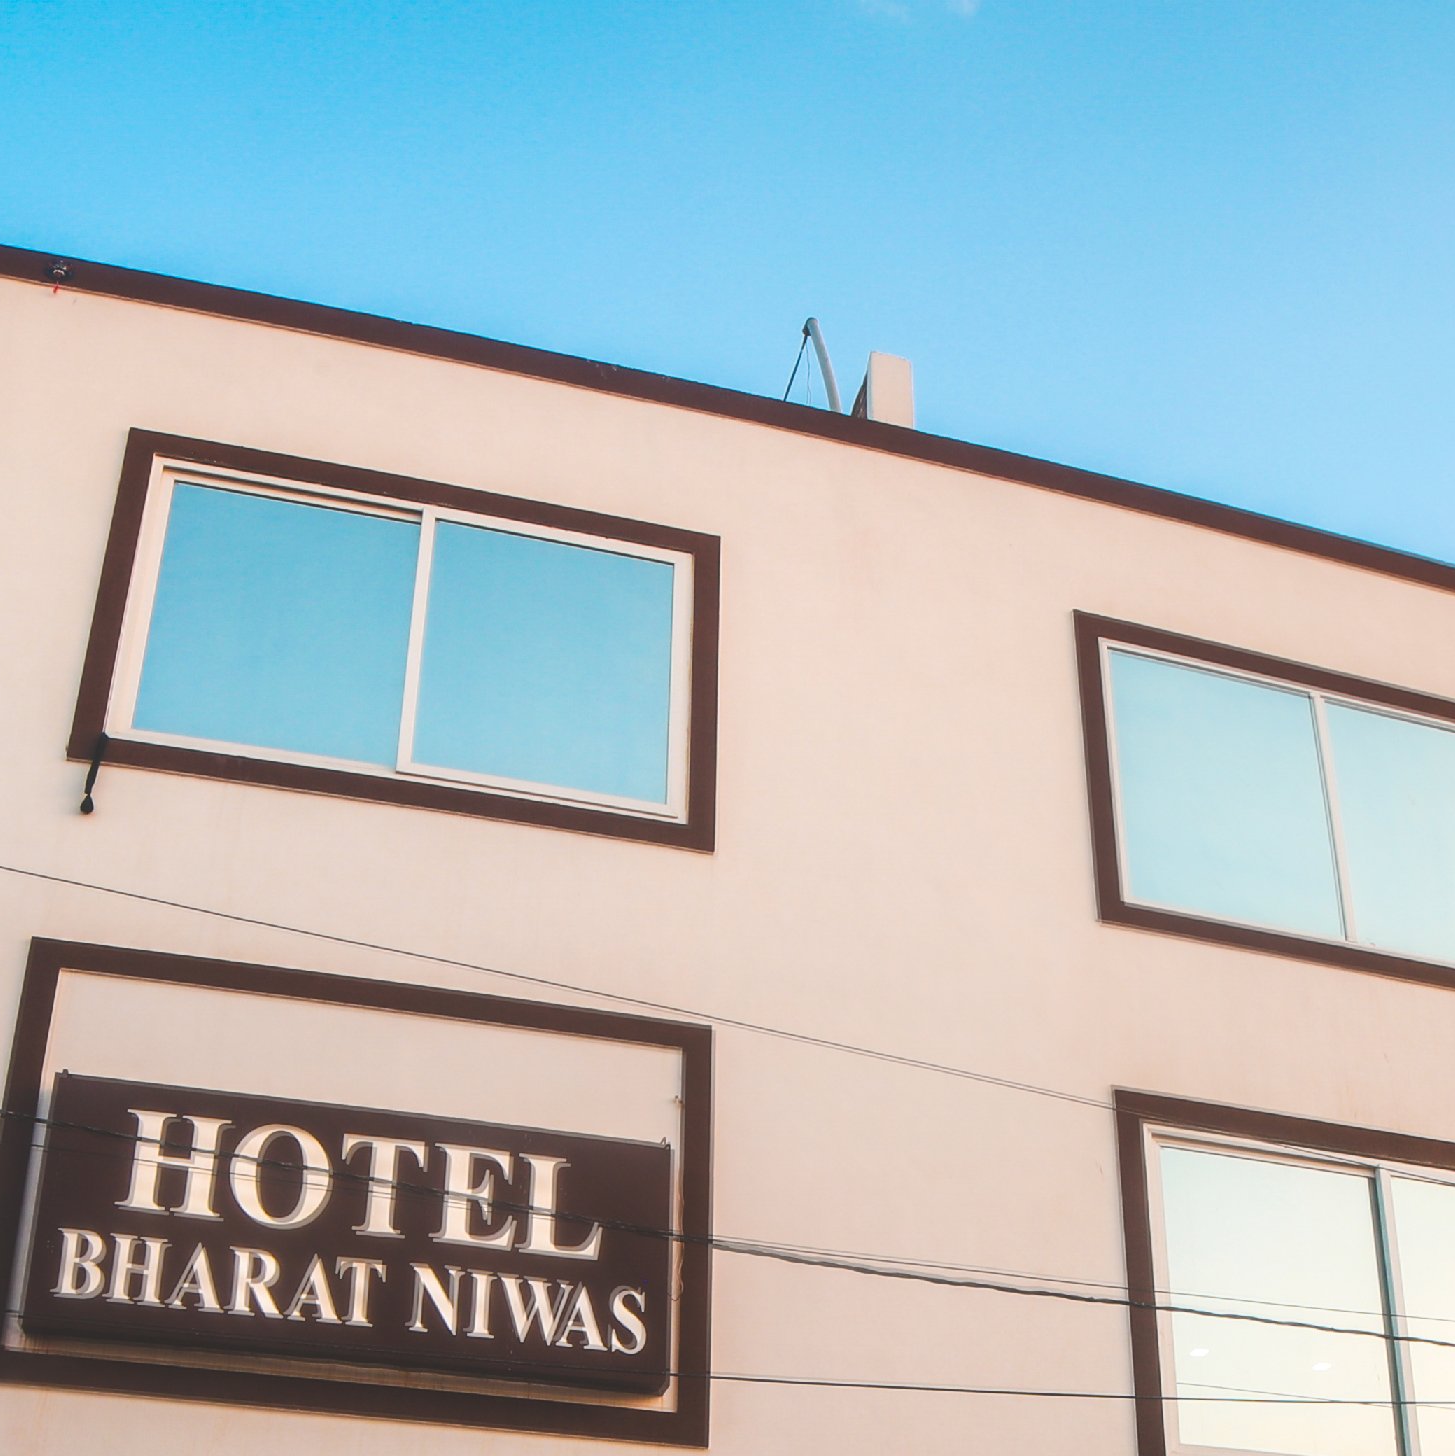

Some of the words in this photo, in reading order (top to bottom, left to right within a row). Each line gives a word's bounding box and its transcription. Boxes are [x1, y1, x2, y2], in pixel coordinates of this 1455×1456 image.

[114, 1107, 604, 1261] HOTEL
[51, 1227, 387, 1328] BHARAT
[408, 1262, 647, 1356] NIWAS
